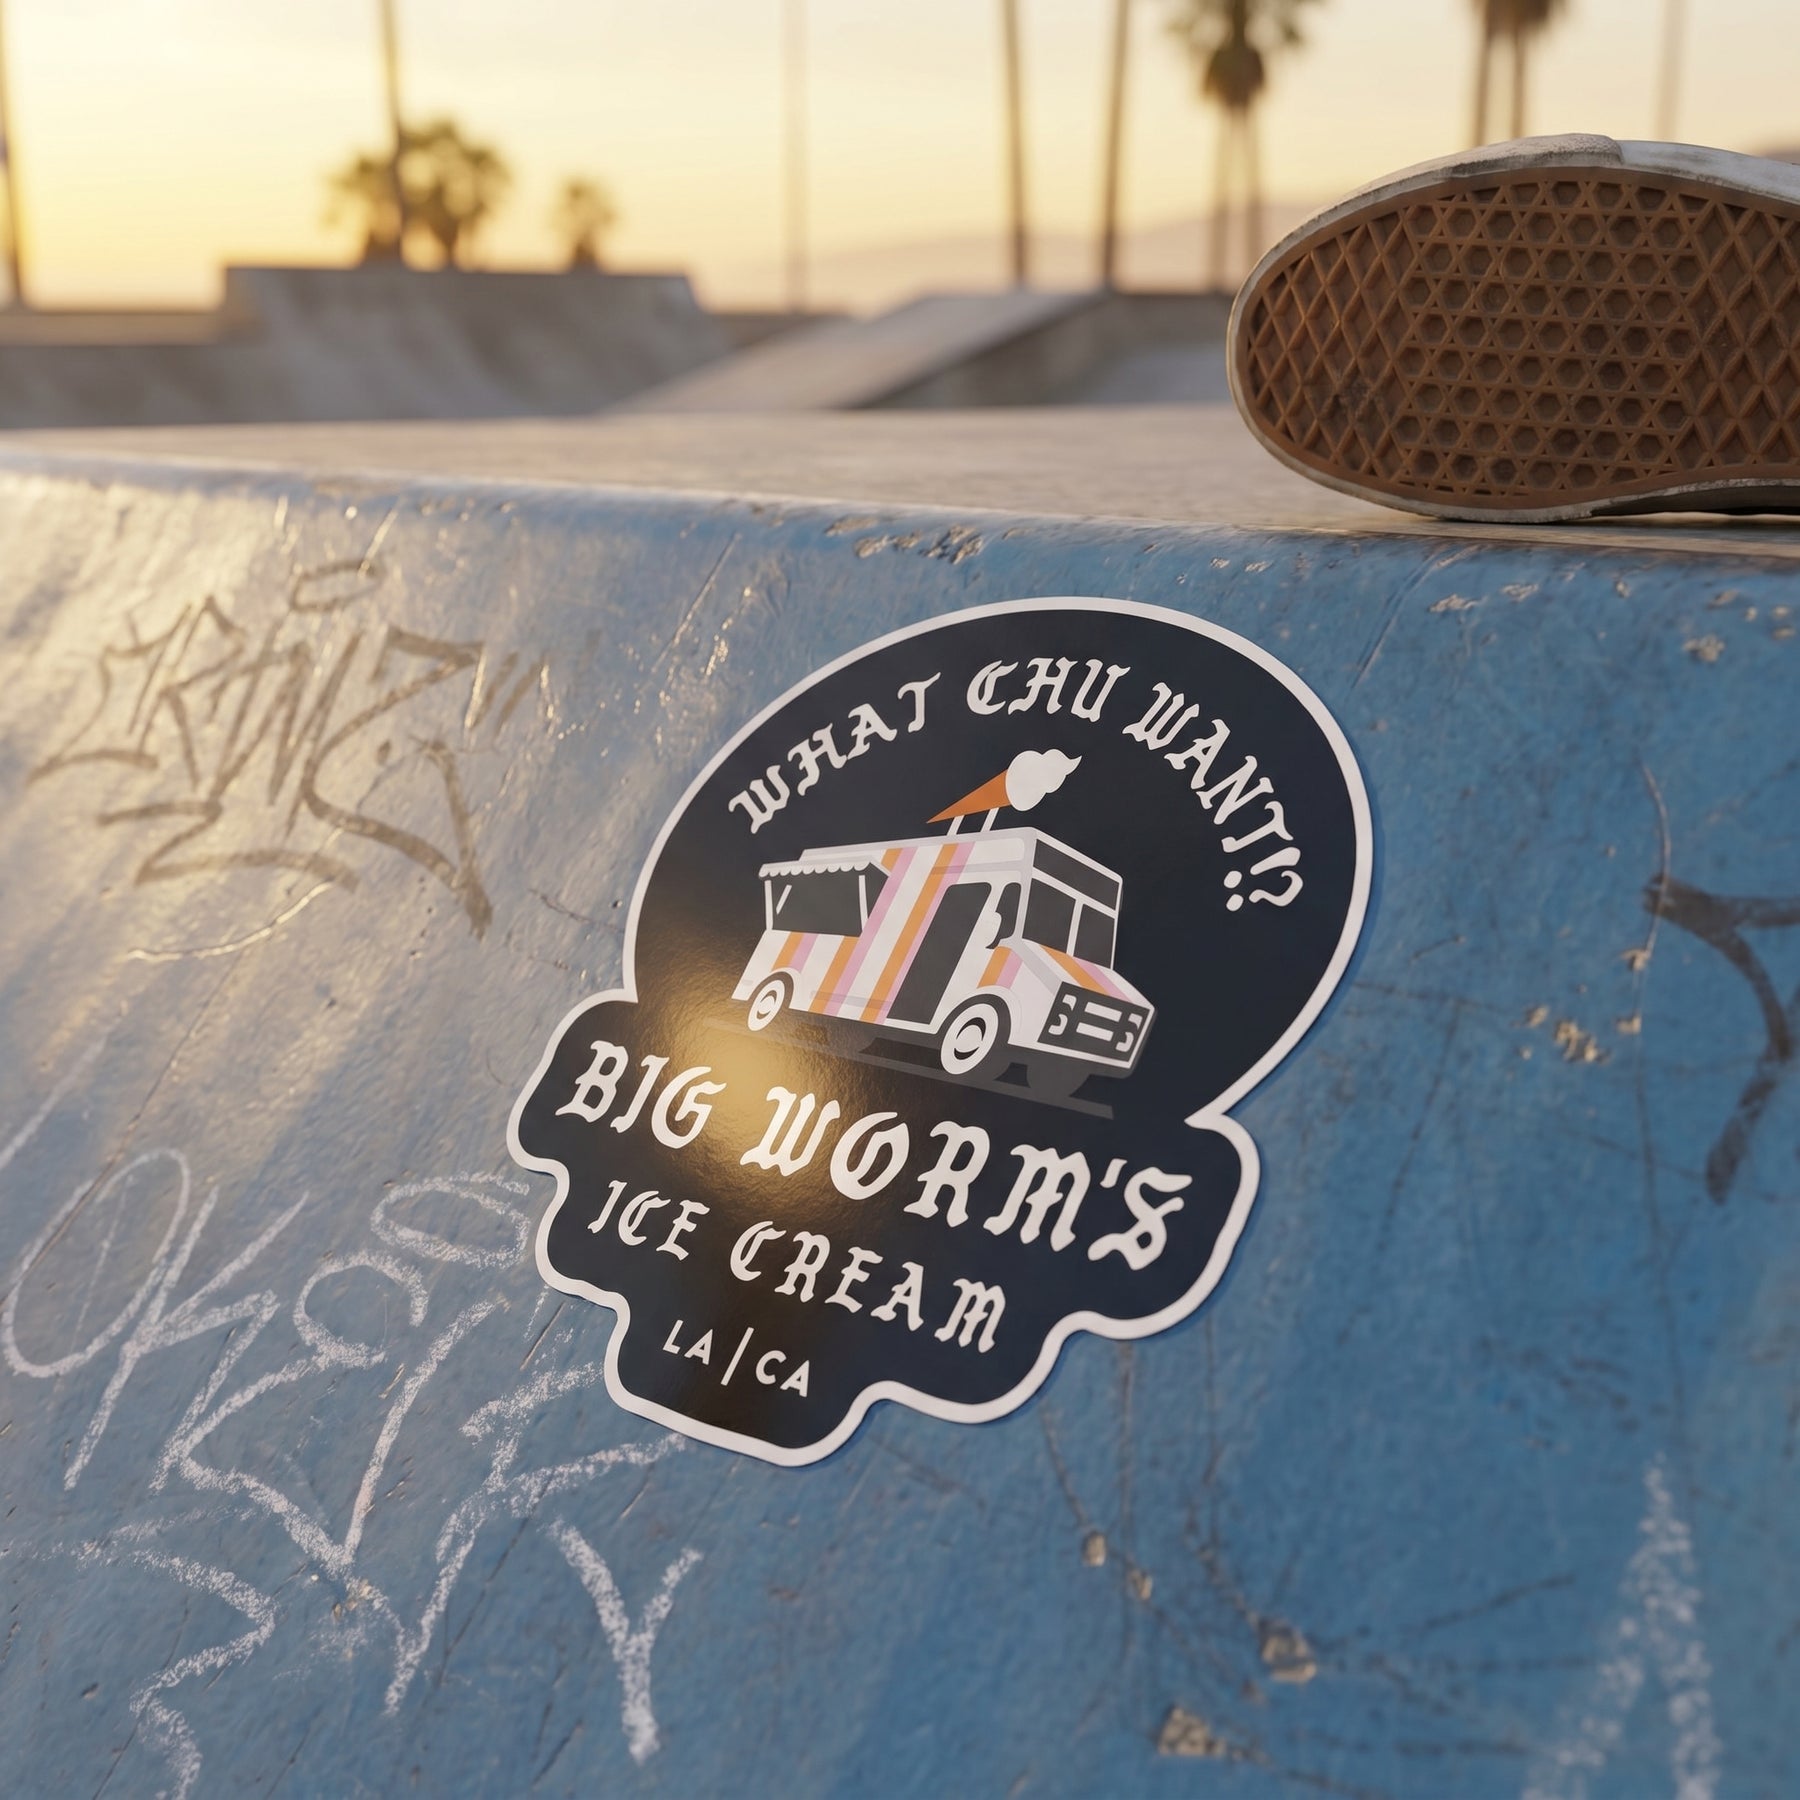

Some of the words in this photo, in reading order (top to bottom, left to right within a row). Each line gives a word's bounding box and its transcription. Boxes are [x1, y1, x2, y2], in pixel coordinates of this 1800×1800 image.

[728, 671, 941, 834] WHAT
[966, 656, 1131, 723] CHU
[555, 1040, 728, 1149] BIG
[739, 1085, 1193, 1271] WORM'S
[587, 1179, 711, 1261] ICE
[730, 1220, 1006, 1353] CREAM
